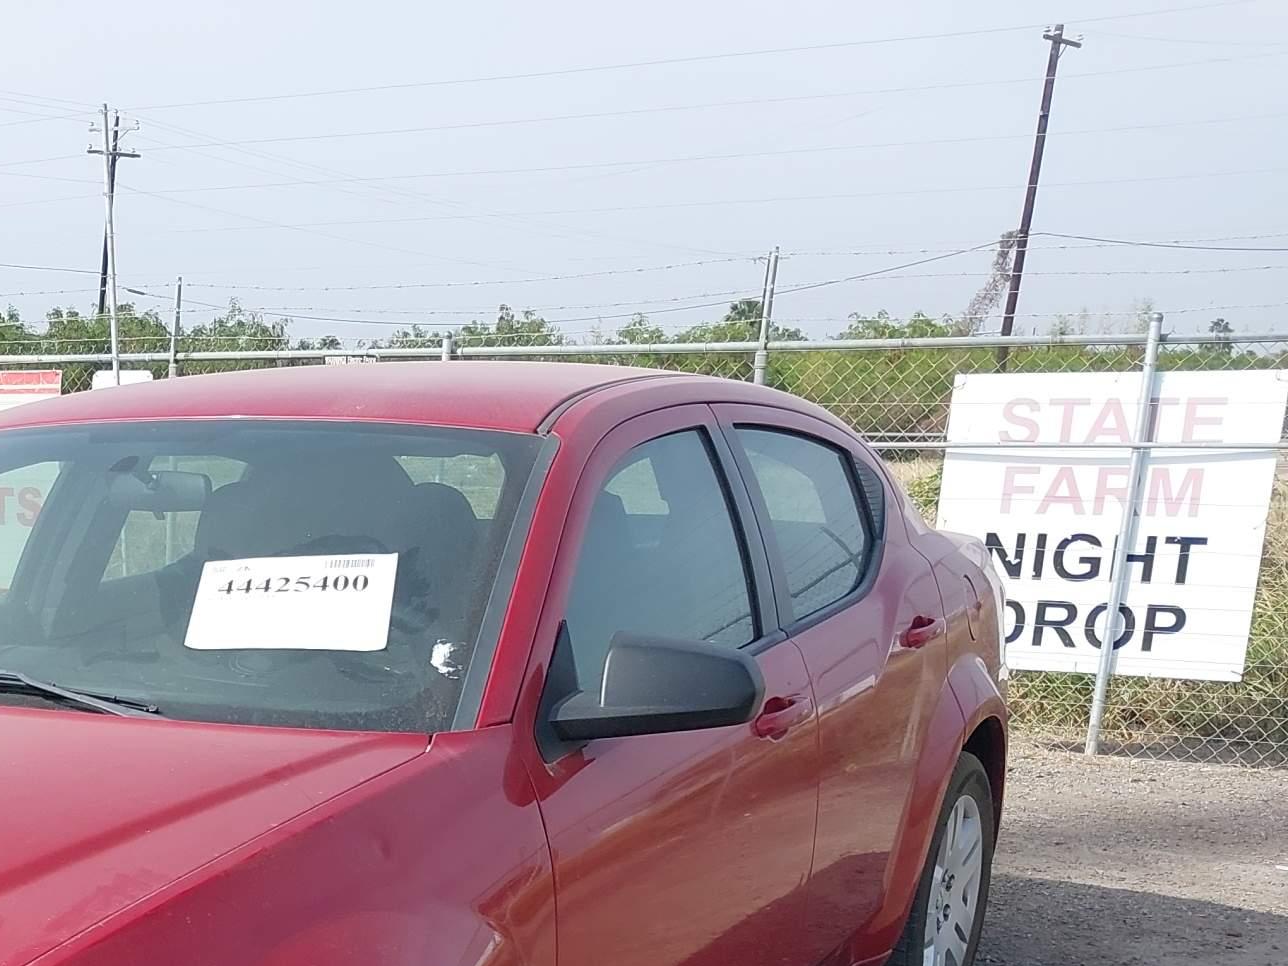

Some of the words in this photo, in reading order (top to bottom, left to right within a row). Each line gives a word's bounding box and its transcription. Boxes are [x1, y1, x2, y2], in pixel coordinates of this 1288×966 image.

[999, 397, 1228, 443] STATE
[1000, 466, 1205, 517] FARM
[985, 532, 1208, 585] NIGHT
[218, 575, 369, 594] 44425400
